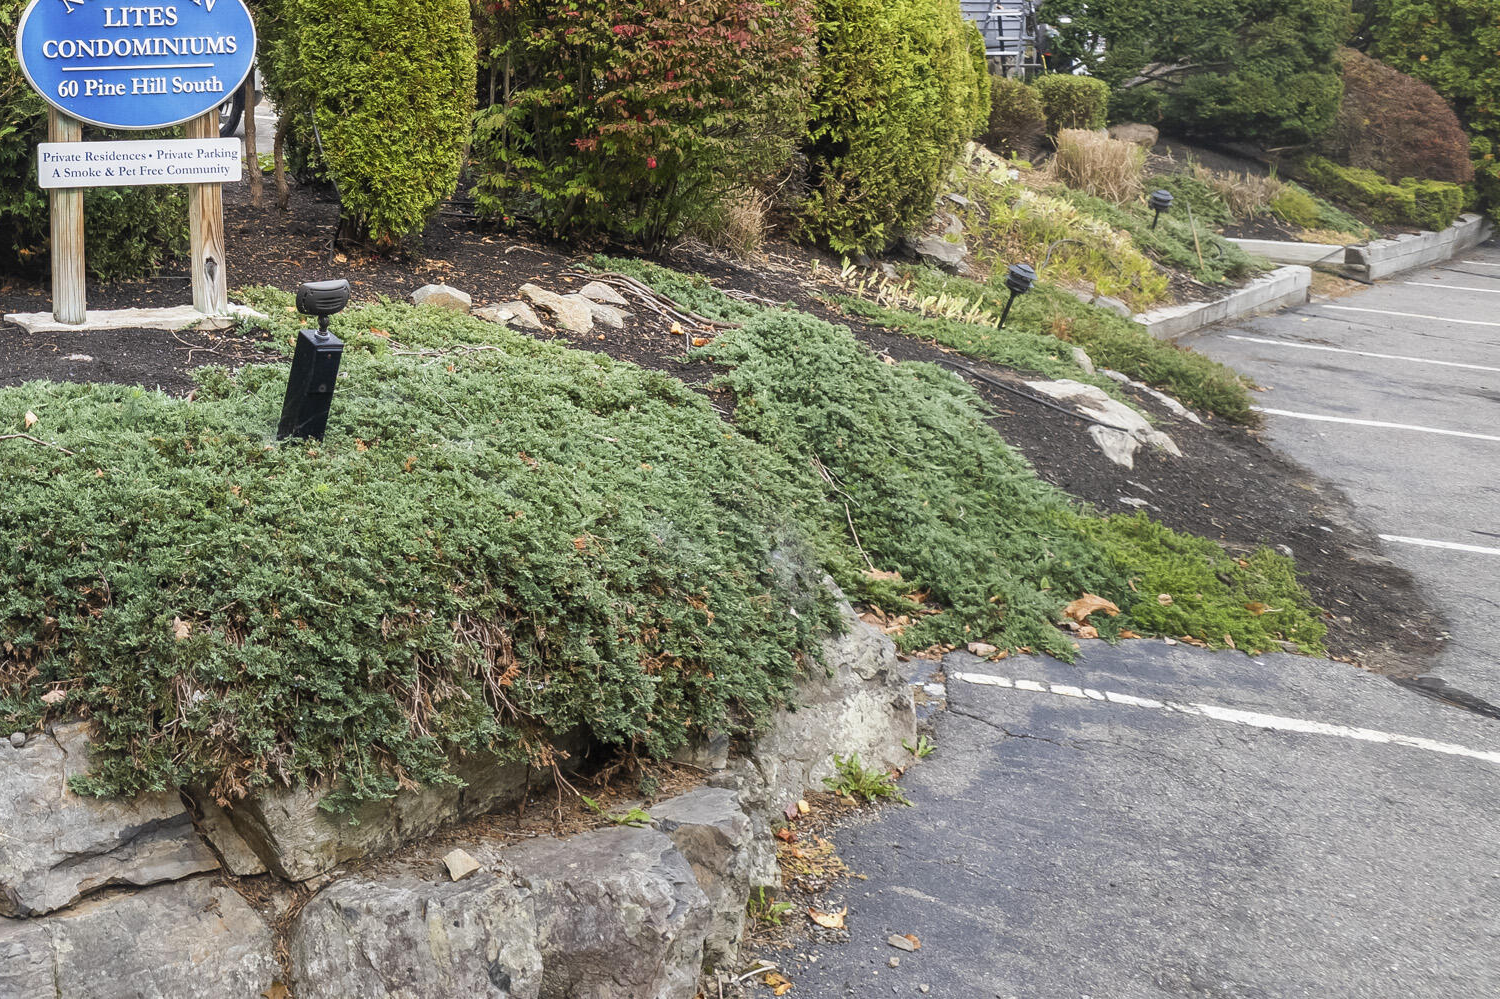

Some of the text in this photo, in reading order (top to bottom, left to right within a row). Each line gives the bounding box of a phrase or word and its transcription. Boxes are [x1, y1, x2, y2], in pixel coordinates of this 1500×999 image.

[103, 6, 179, 28] LITES
[42, 35, 238, 59] CONDOMINIUMS
[57, 75, 224, 98] 60 Pine Hill South
[43, 148, 238, 162] Private Residences Private Parking
[52, 164, 230, 178] A Smoke & Pet Free Community
